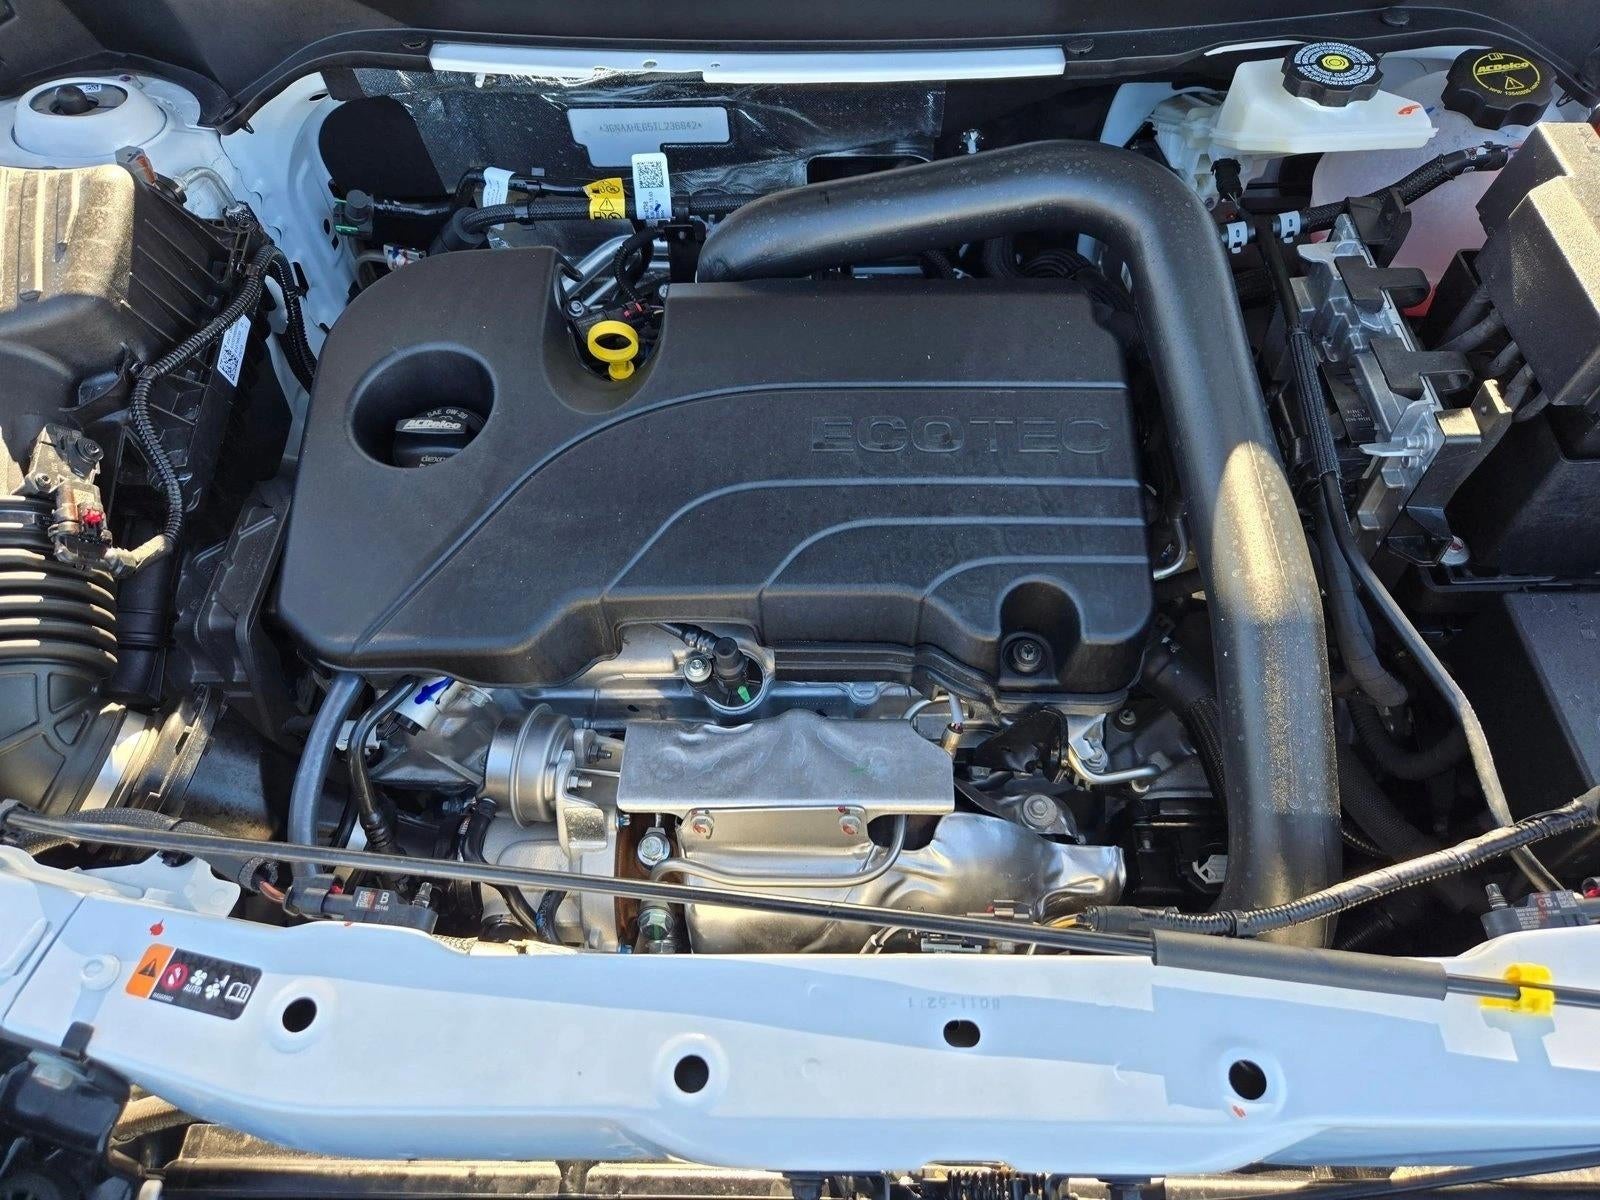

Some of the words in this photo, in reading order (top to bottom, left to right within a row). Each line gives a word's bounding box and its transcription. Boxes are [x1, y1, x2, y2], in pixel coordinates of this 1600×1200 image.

[1476, 62, 1530, 75] ACDelco
[427, 410, 442, 418] SAE
[403, 419, 461, 430] ACDelco
[811, 415, 1111, 453] ECOTEC
[183, 983, 202, 994] AUTO
